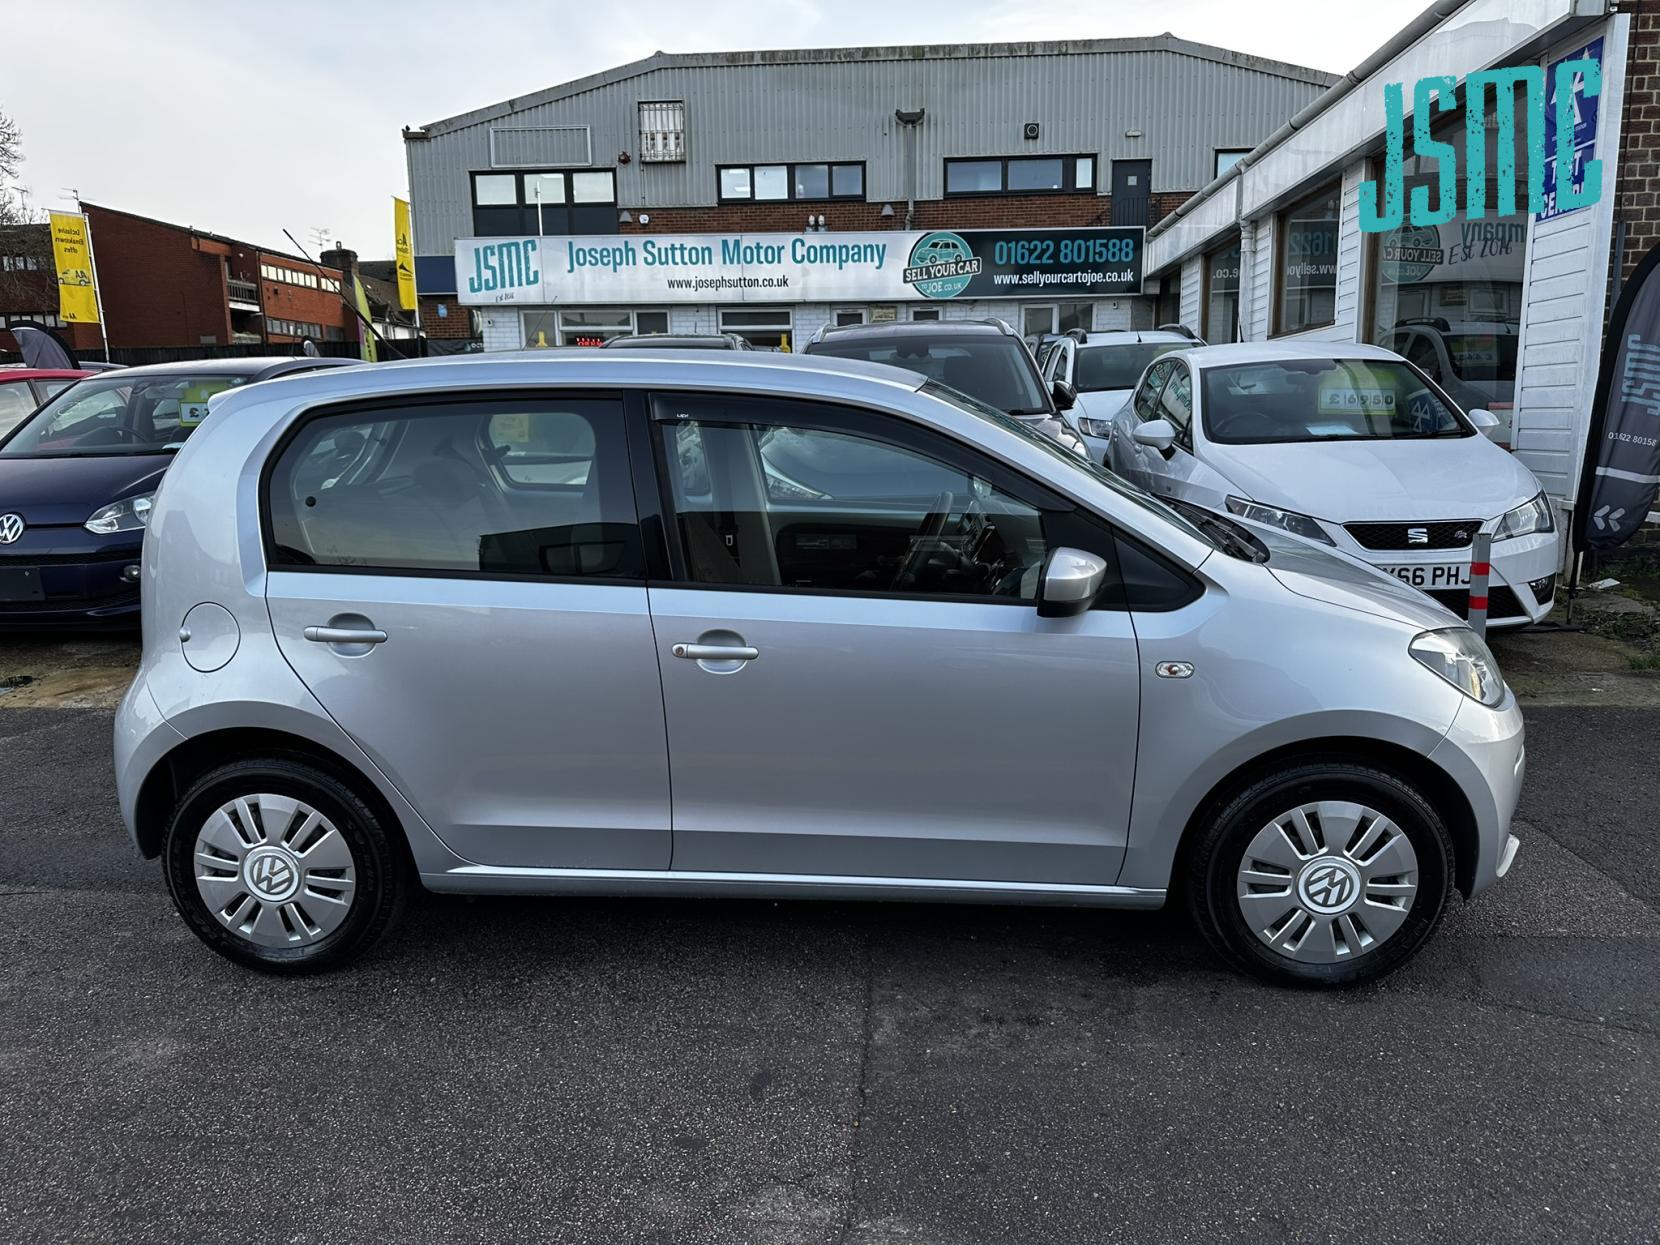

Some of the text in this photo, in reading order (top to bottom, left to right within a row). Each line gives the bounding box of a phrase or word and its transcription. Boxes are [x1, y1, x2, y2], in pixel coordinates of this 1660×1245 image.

[568, 238, 887, 273] Joseph Sutton Motor Company
[994, 238, 1134, 265] 01622 801588
[469, 239, 540, 293] JSMC
[905, 260, 978, 282] SELL YOUR CAR
[667, 275, 789, 292] www.josephsutton.co.uk
[993, 269, 1134, 287] www.sellyourcartojoe.co.uk
[1608, 431, 1631, 443] 01622
